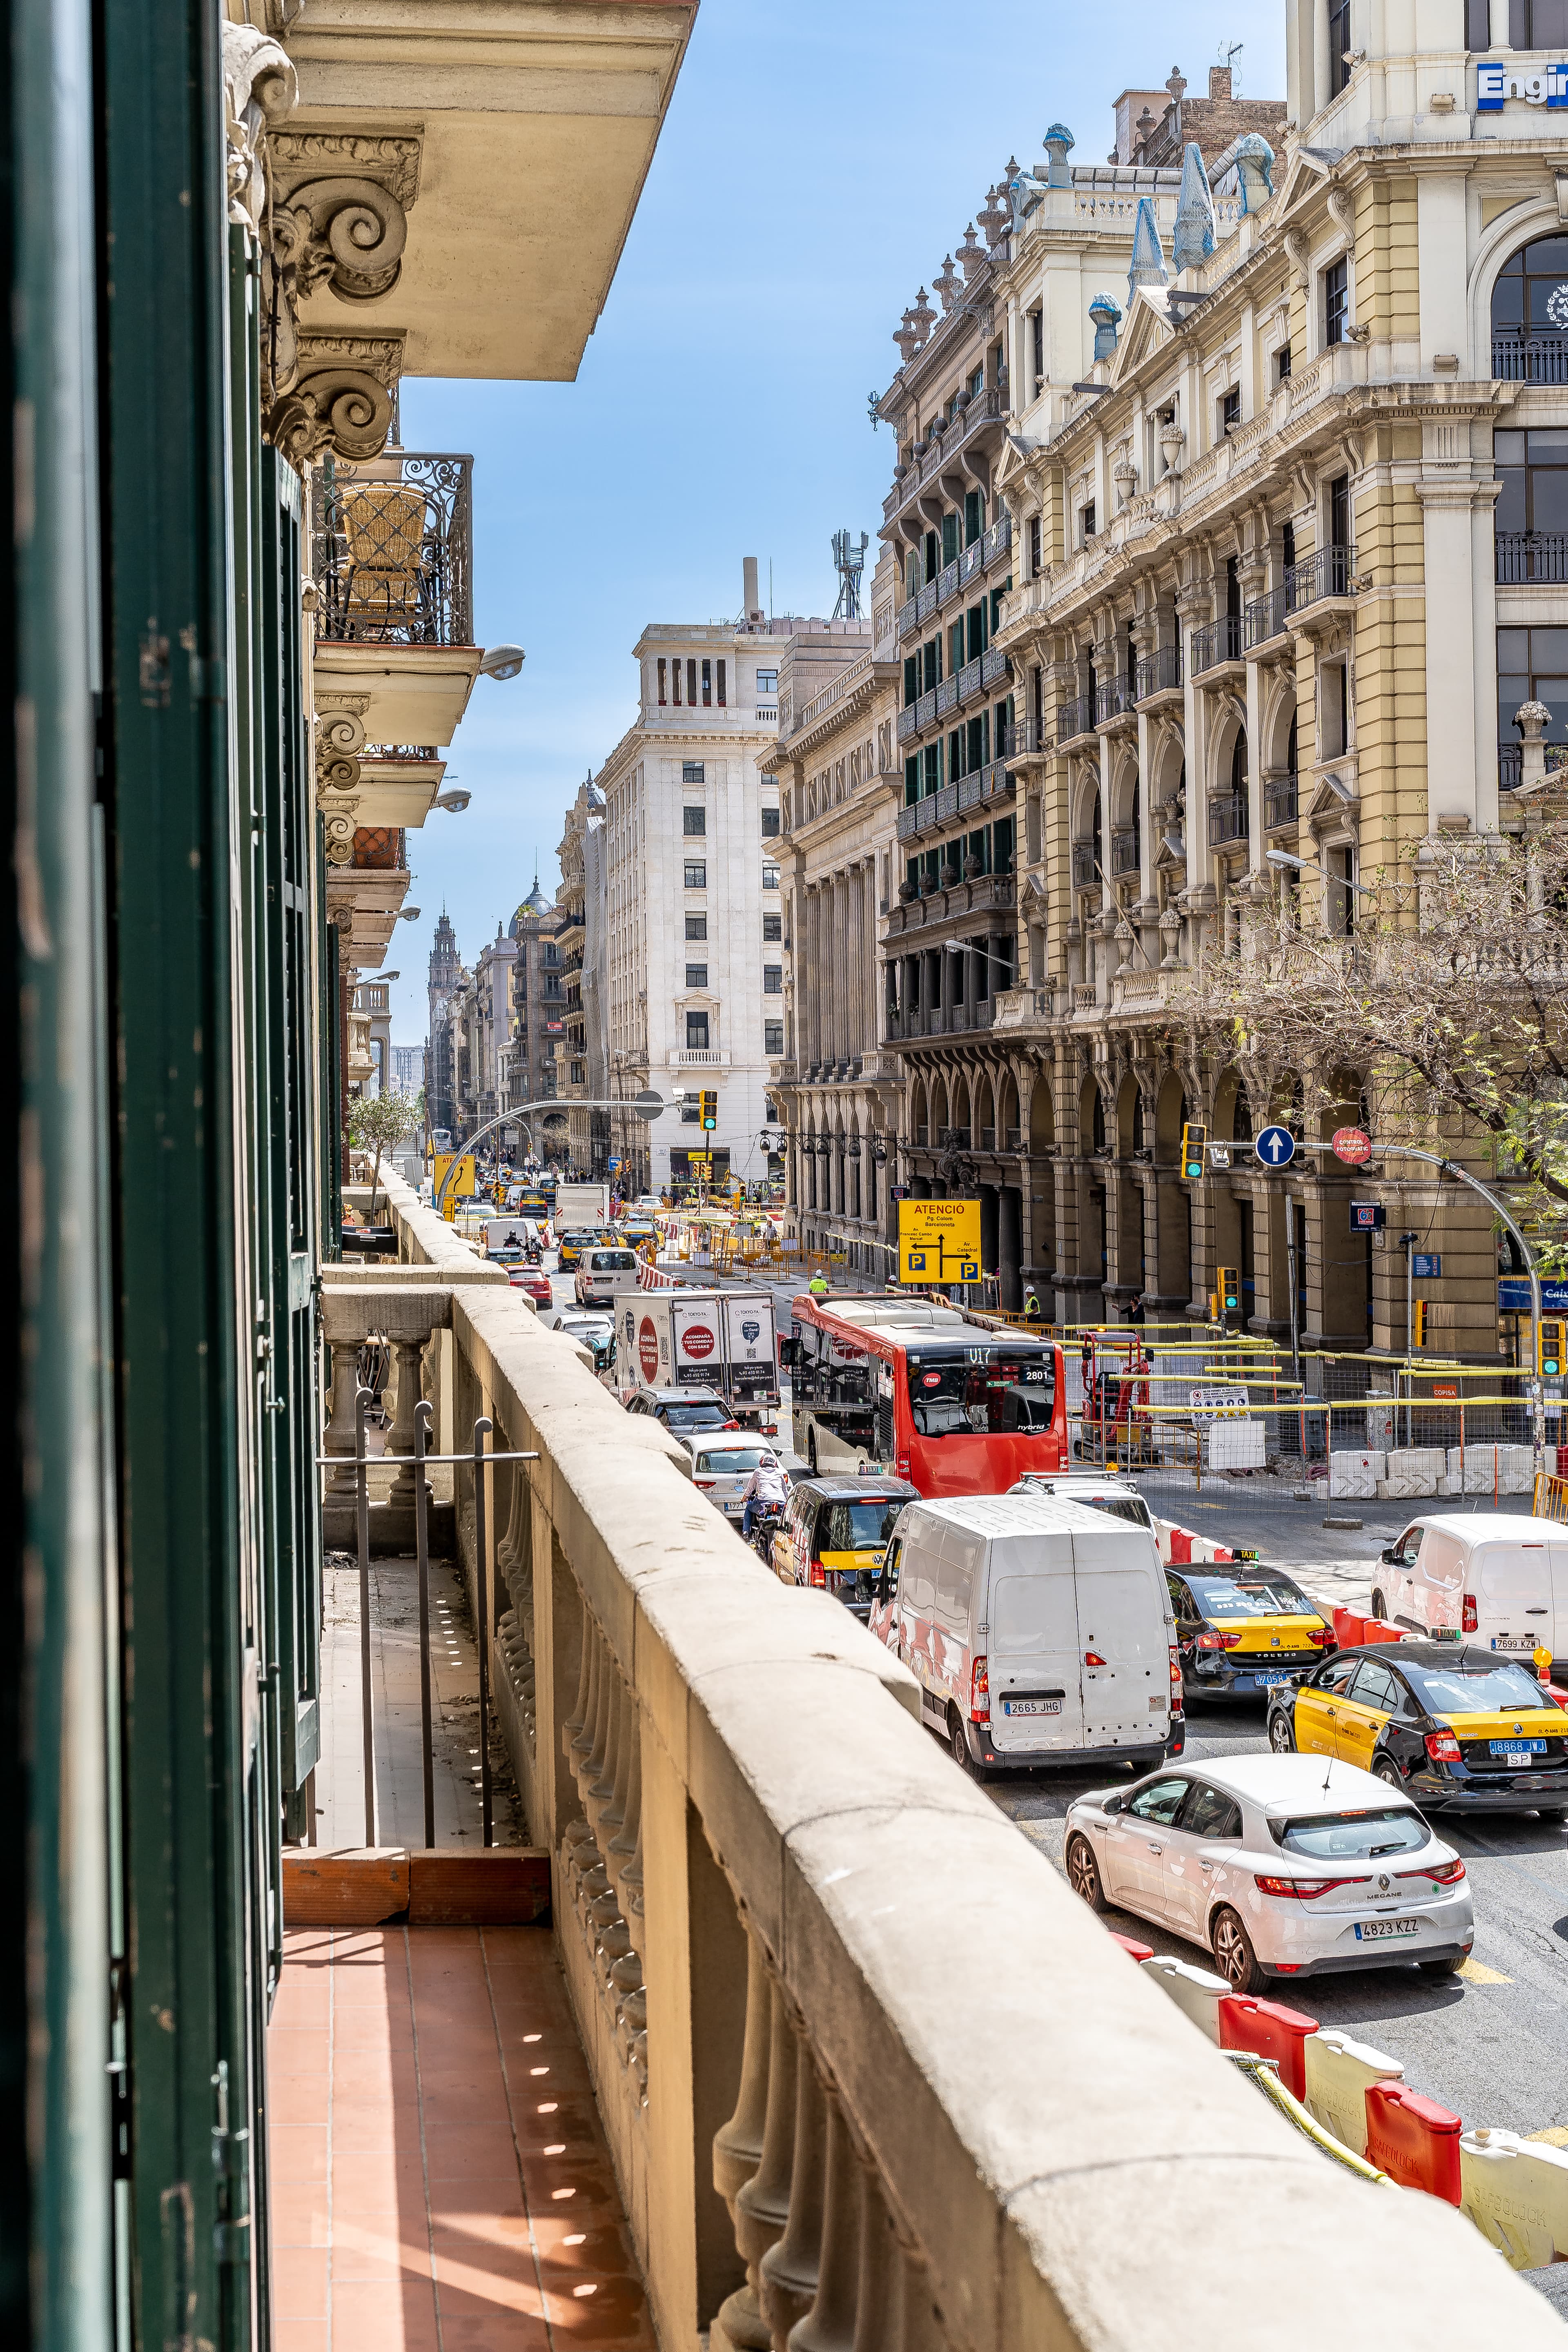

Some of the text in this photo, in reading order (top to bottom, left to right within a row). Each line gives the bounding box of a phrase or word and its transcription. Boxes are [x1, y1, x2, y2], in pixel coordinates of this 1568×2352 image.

[914, 1203, 965, 1214] ATENCIÓ
[911, 1255, 922, 1269] P
[964, 1264, 975, 1278] P
[969, 1348, 991, 1364] V17
[1026, 1371, 1048, 1380] 2801
[1241, 1550, 1254, 1559] TAXI
[1441, 1629, 1455, 1637] TAXI
[1521, 1640, 1536, 1648] KZW
[1261, 1675, 1283, 1684] 7058
[1012, 1702, 1058, 1713] 2665 JHG
[1497, 1741, 1544, 1752] 8868 JWJ
[1367, 1891, 1402, 1900] MEGANE
[1363, 1922, 1393, 1936] 4823
[1396, 1919, 1419, 1933] KZZ
